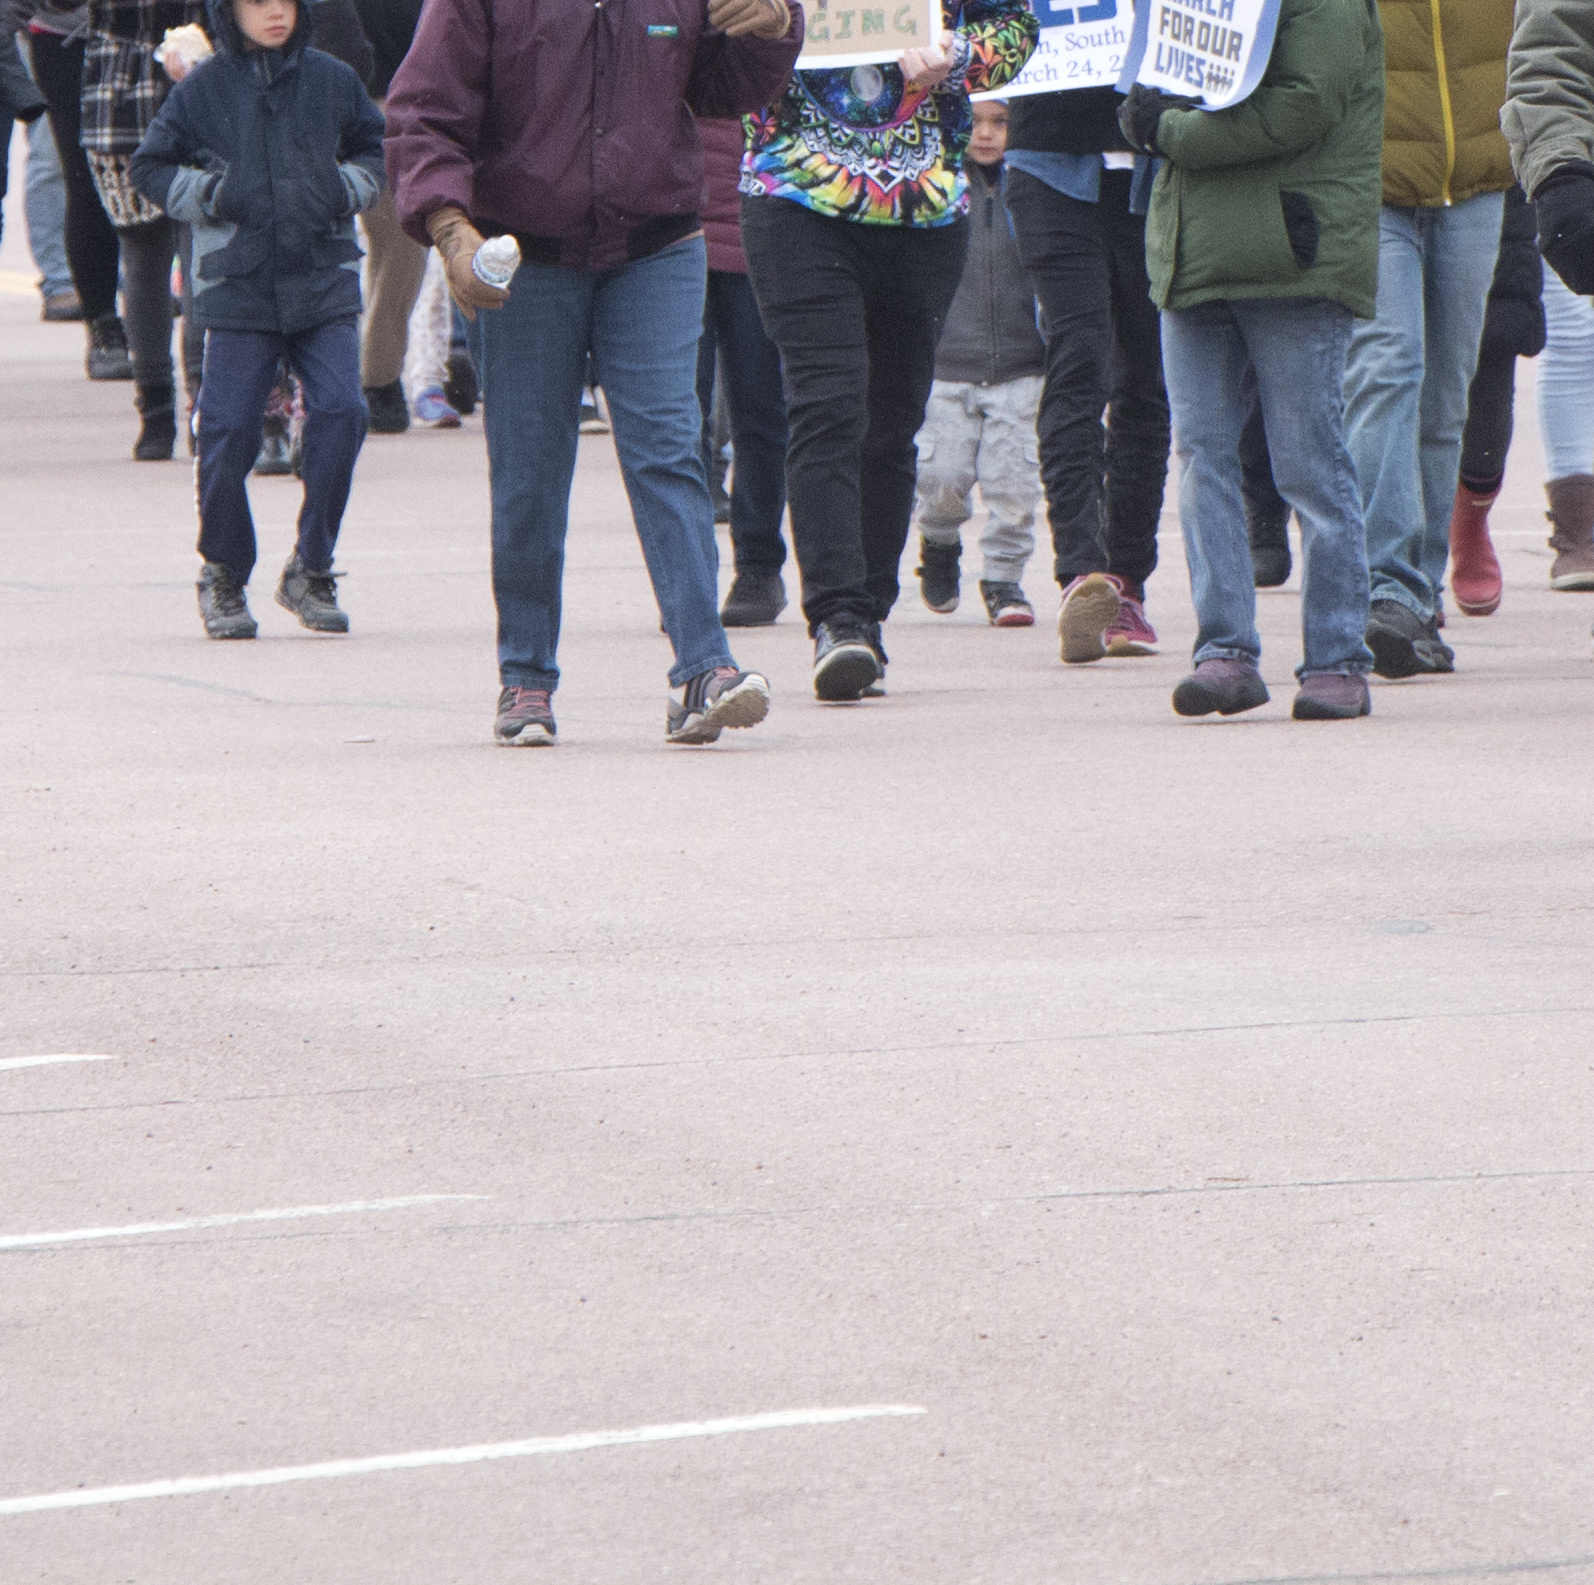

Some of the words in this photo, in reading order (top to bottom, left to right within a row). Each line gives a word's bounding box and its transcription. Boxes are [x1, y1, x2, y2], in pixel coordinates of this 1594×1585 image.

[807, 5, 917, 43] GING
[1065, 26, 1126, 52] South
[1159, 5, 1195, 47] FOR
[1196, 20, 1243, 63] OUR
[1067, 59, 1103, 81] 24,
[1154, 41, 1206, 89] LIVES
